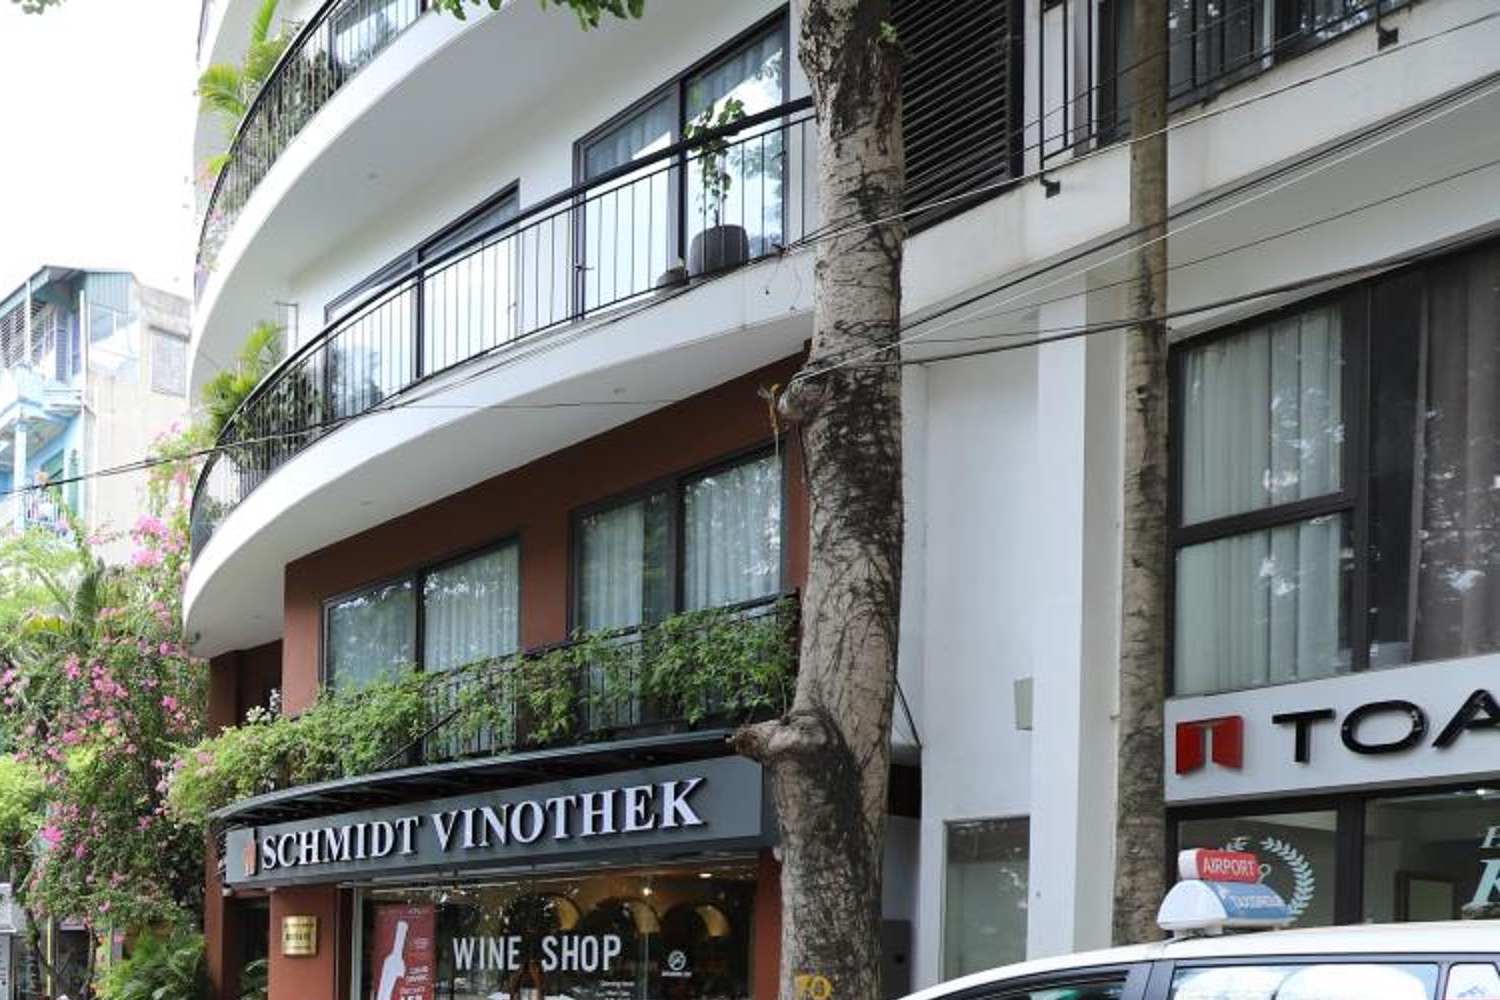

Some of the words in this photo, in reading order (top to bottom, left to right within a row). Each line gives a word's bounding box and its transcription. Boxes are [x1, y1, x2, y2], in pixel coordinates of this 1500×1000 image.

[261, 816, 419, 870] SCHMIDT
[430, 777, 704, 850] VINOTHEK
[1203, 857, 1255, 877] AIRPORT
[453, 936, 522, 971] WINE
[541, 935, 622, 973] SHOP
